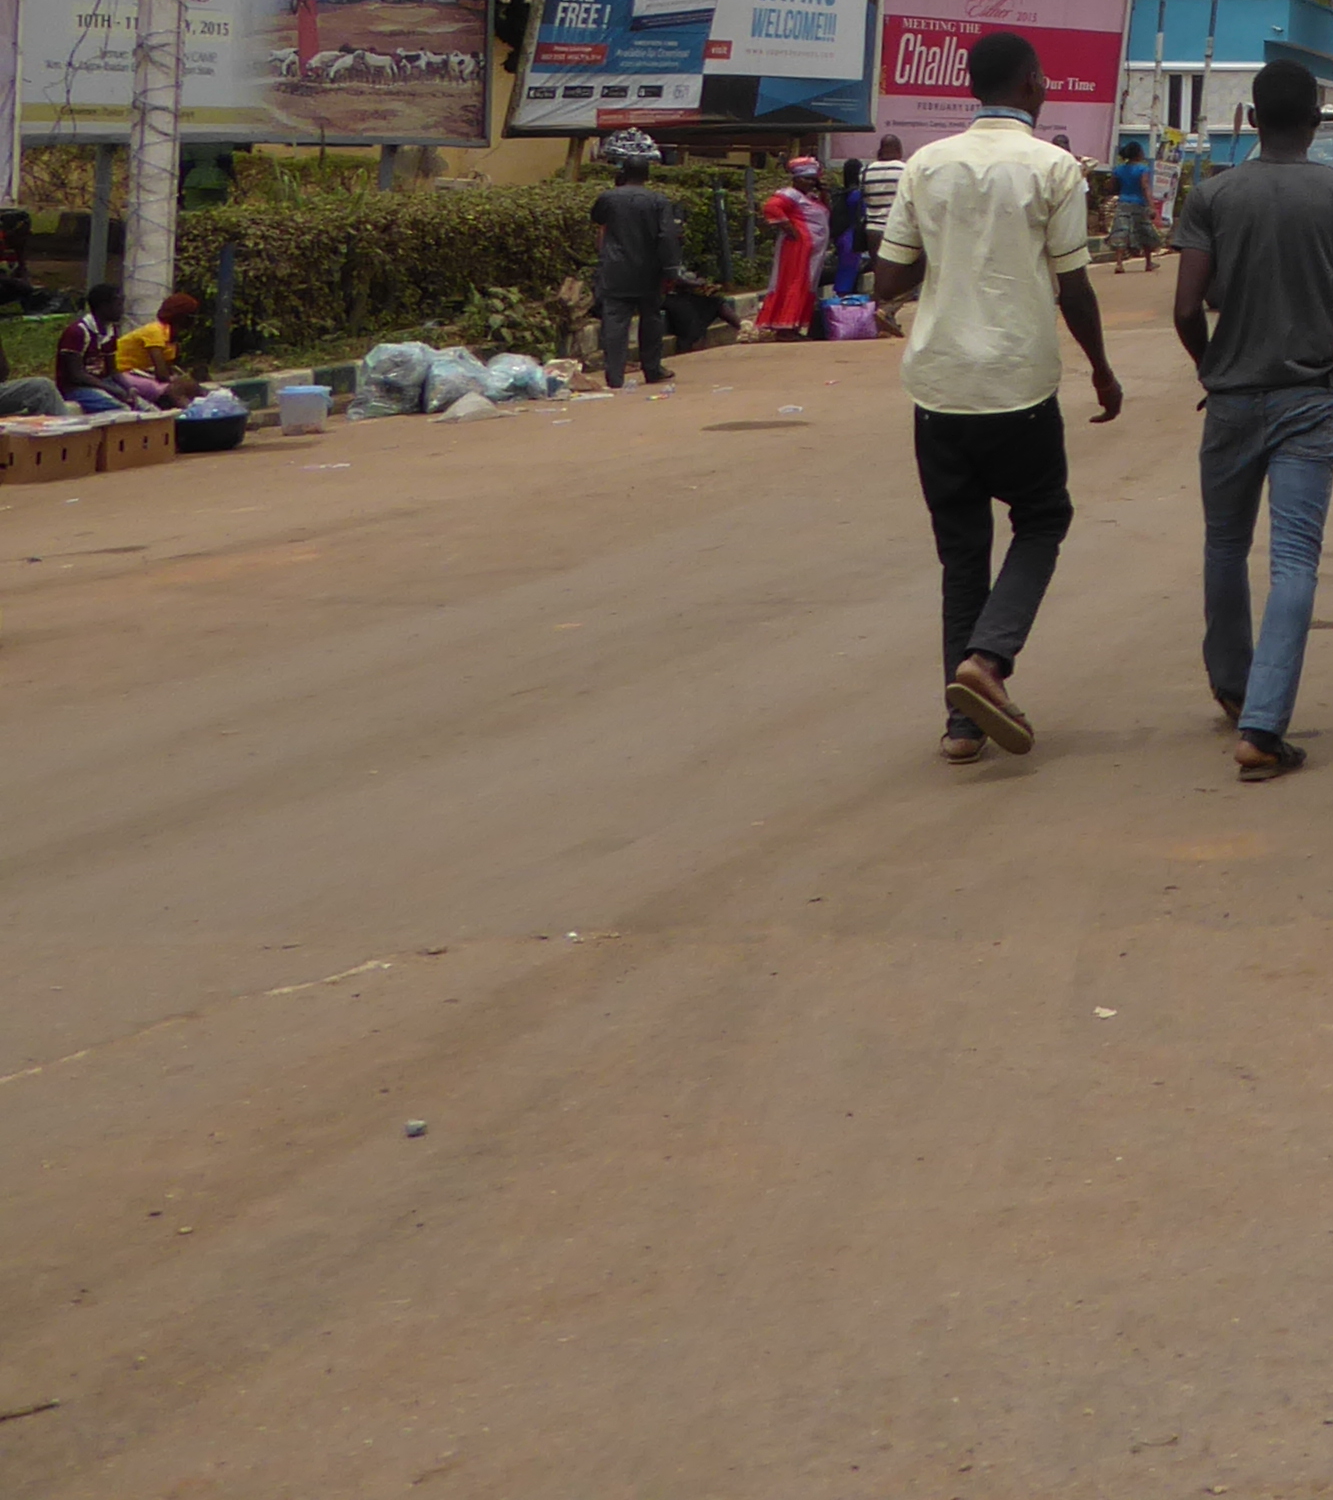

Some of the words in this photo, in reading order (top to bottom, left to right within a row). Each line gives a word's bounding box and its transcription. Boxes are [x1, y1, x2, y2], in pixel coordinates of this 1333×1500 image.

[76, 13, 112, 29] 10TH
[200, 20, 229, 36] 2015
[751, 7, 837, 43] WELCOME!!!
[903, 17, 956, 33] MEETING
[960, 22, 982, 34] THE
[1067, 77, 1096, 91] Time
[917, 102, 962, 111] FEBRUARY
